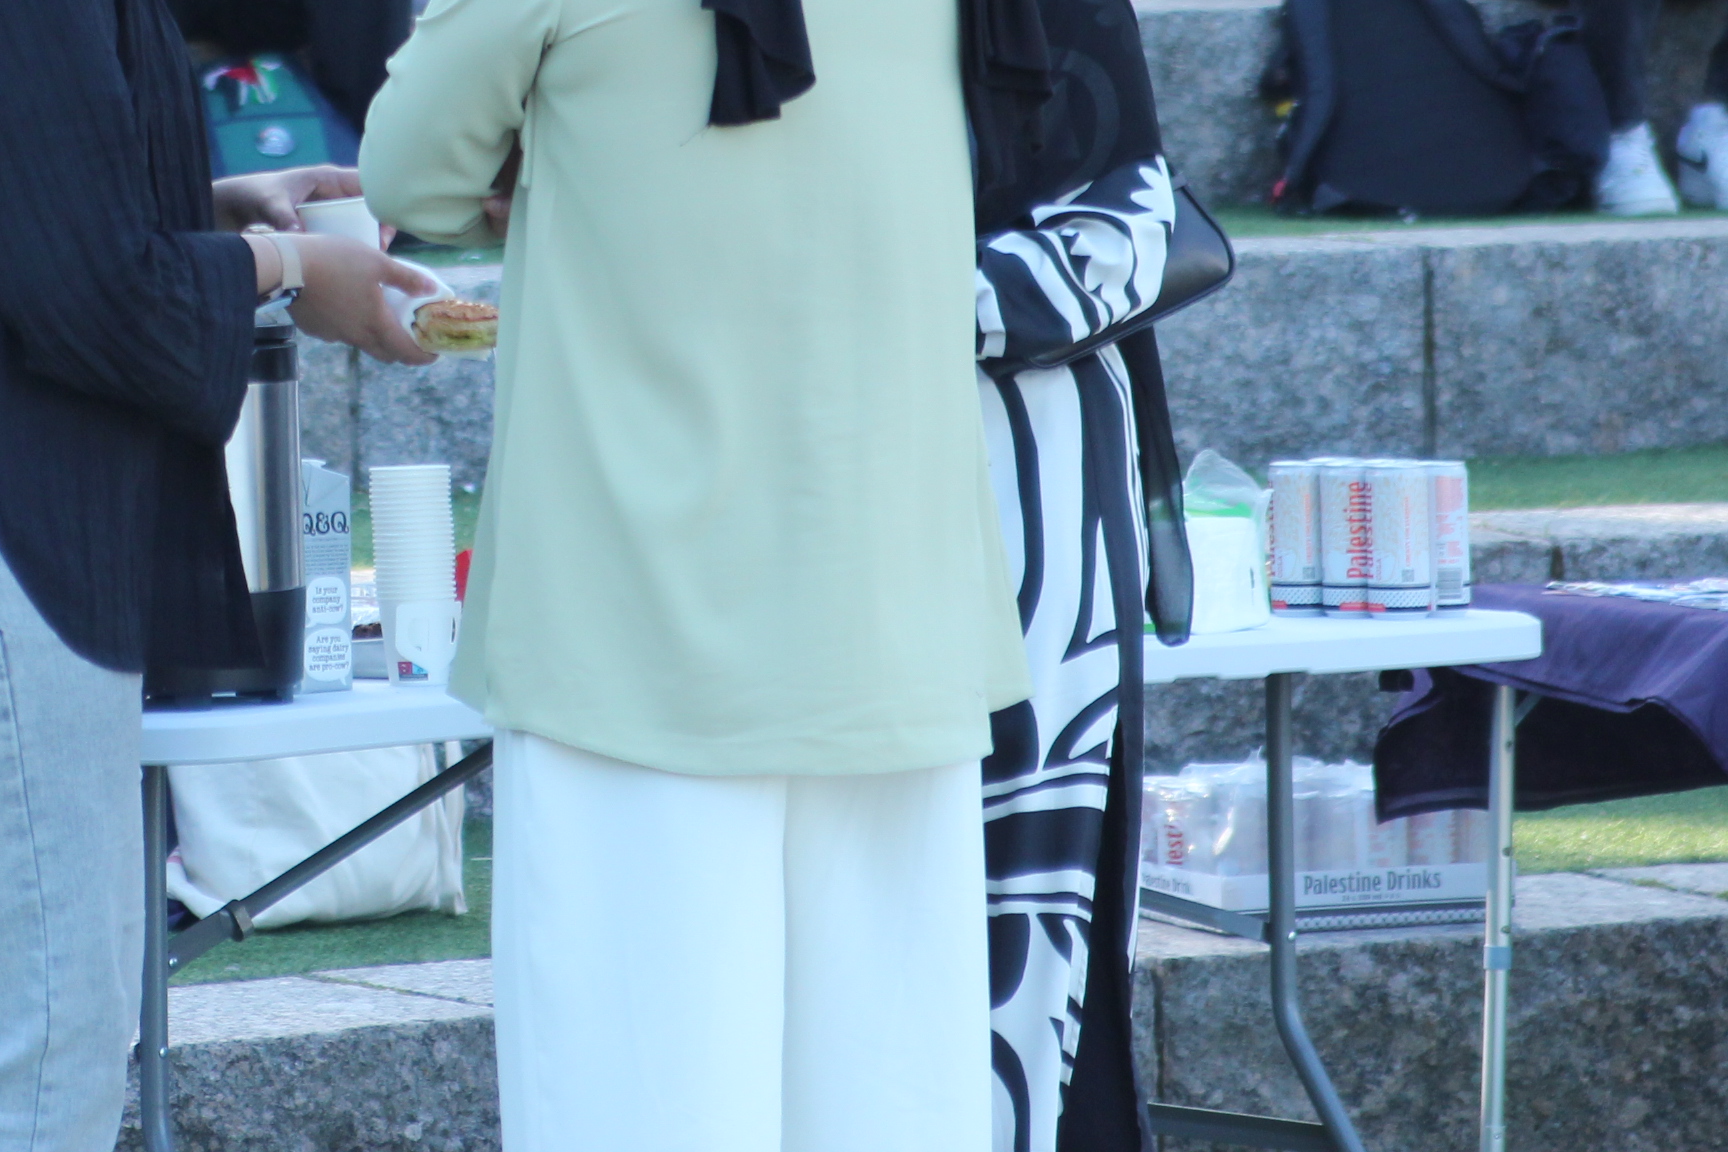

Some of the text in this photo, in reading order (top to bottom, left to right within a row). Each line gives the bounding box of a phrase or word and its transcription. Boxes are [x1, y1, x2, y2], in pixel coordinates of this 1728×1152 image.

[323, 587, 338, 596] your
[312, 596, 341, 604] company
[330, 636, 341, 644] you
[308, 644, 349, 654] saying dairy
[312, 653, 346, 663] companies
[1304, 868, 1442, 895] Palestine Drinks
